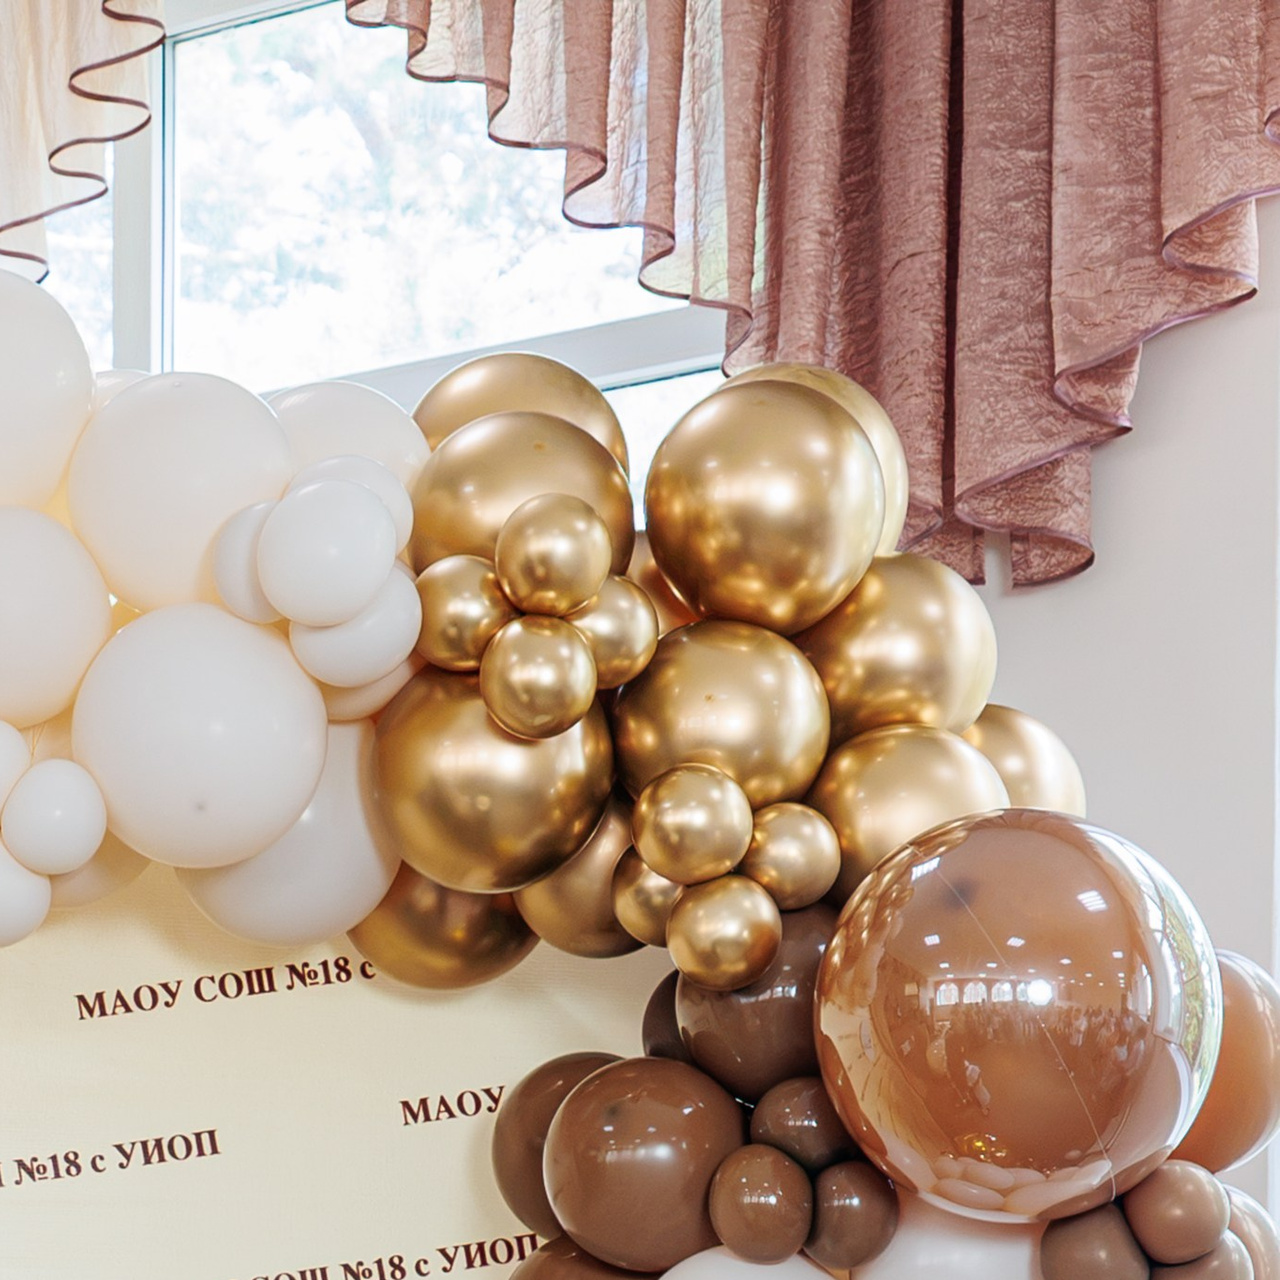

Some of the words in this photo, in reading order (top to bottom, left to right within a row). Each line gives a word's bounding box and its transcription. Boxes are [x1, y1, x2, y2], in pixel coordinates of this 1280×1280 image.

[75, 980, 182, 1021] МАОУ
[194, 966, 277, 1003] СОШ
[285, 956, 352, 991] №18
[359, 960, 376, 980] с
[400, 1085, 505, 1126] МАОУ
[14, 1150, 82, 1186] №18
[90, 1154, 106, 1173] с
[113, 1129, 220, 1170] УИОП
[414, 1258, 430, 1277] с
